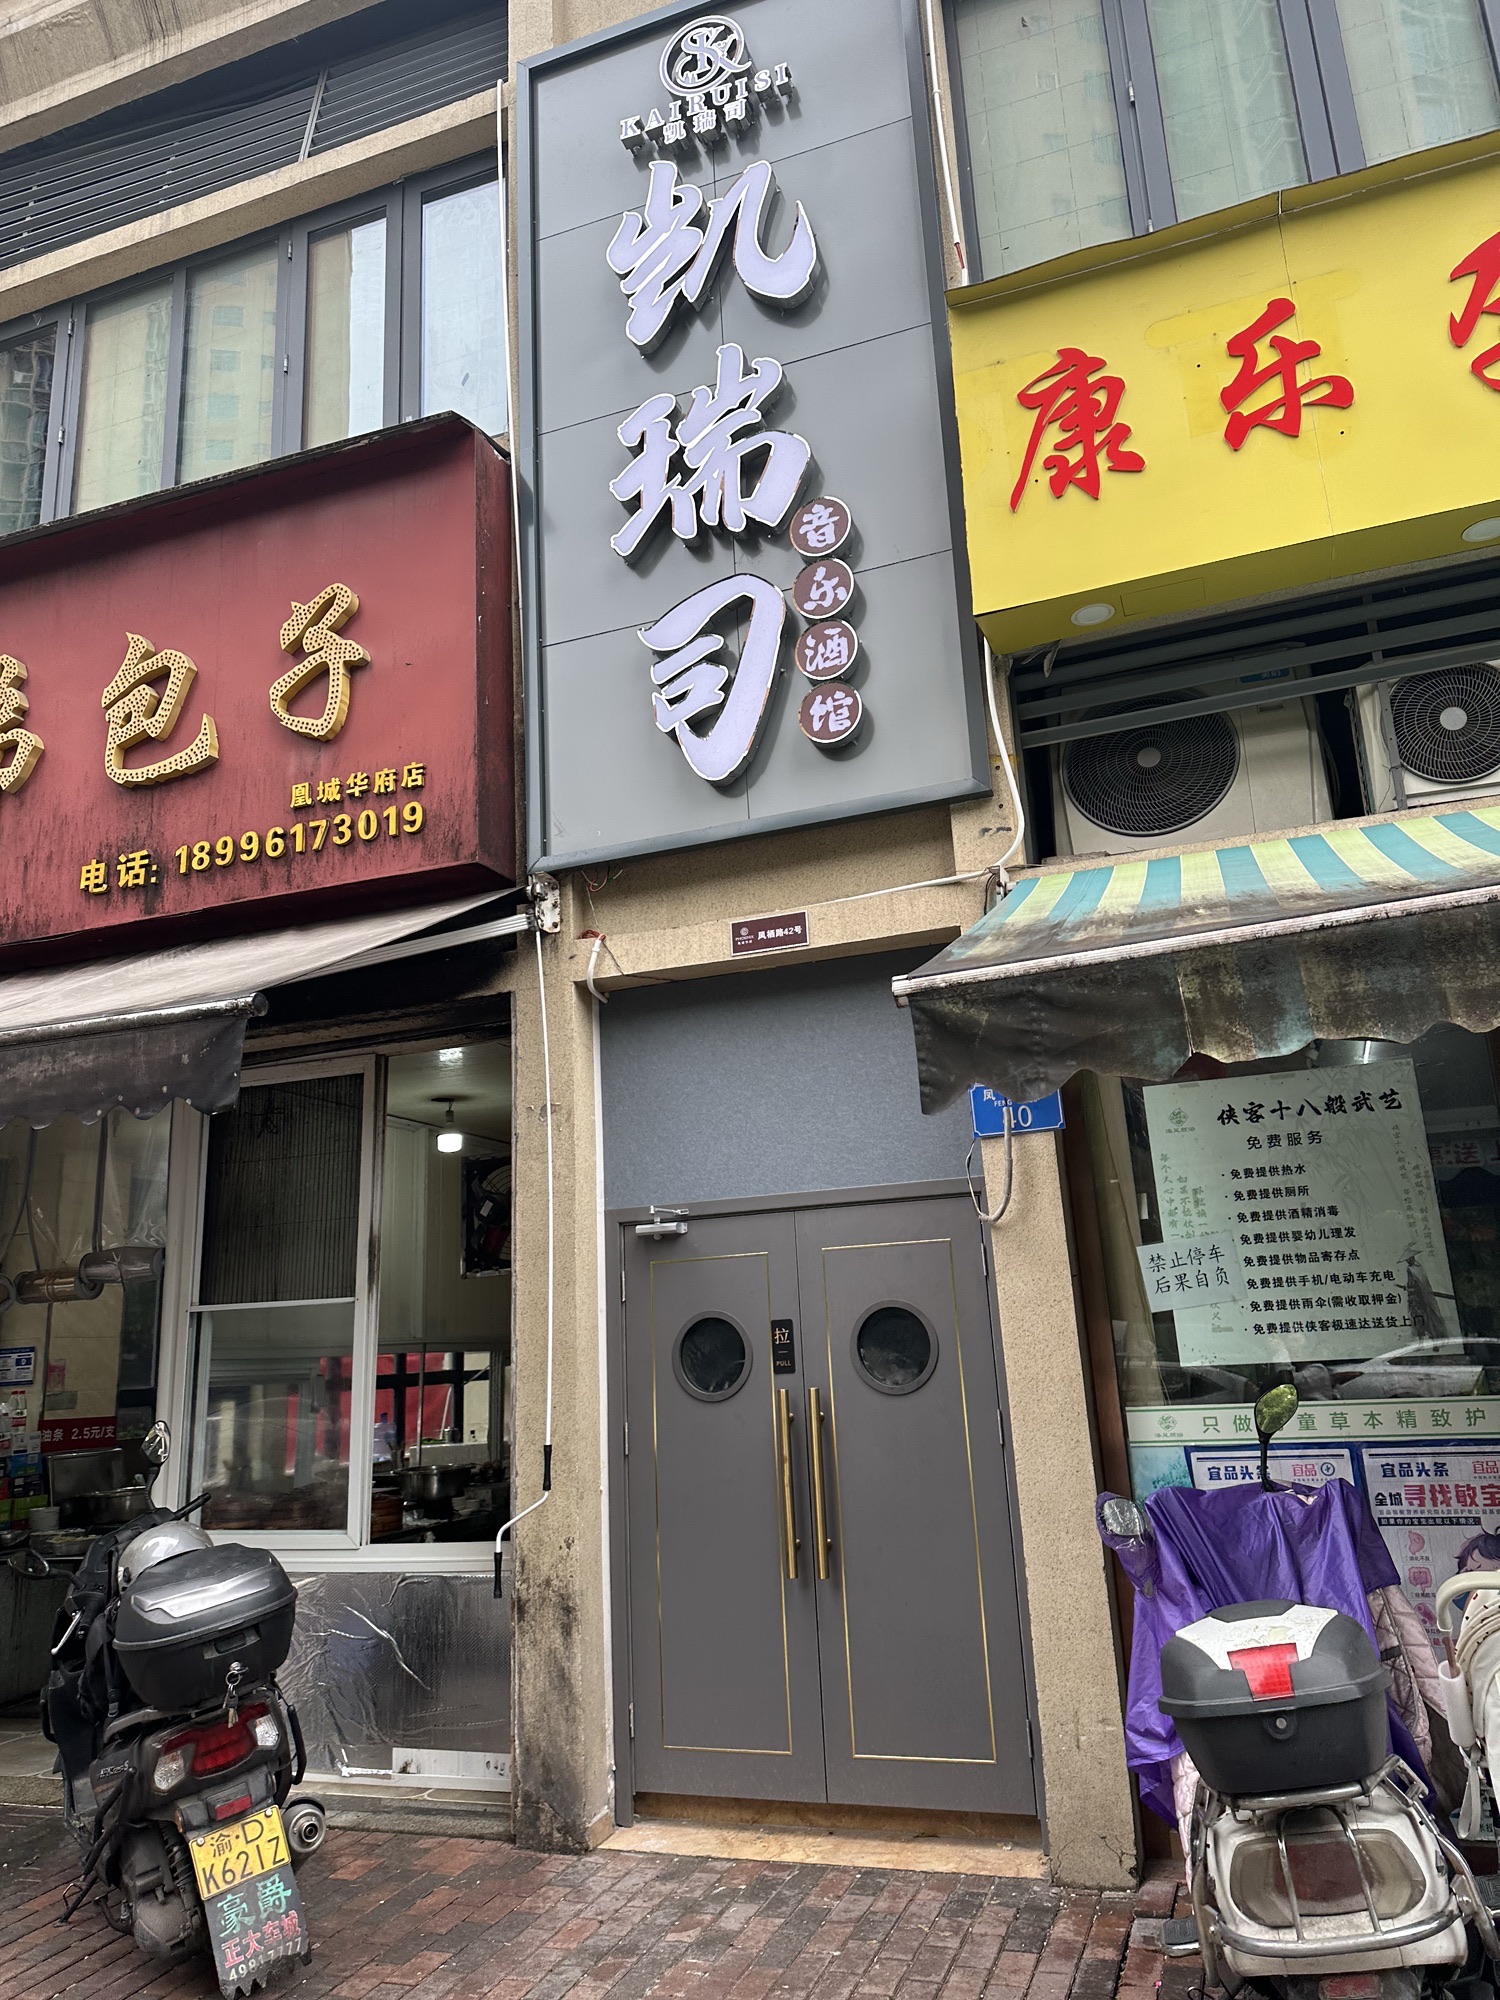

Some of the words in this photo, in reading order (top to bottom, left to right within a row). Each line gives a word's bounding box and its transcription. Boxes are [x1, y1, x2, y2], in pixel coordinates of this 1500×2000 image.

[620, 62, 788, 139] KAIRUISI
[663, 99, 747, 144] 凯瑞司
[606, 160, 817, 781] 凯瑞司
[799, 503, 854, 733] 音乐酒馆
[290, 762, 425, 808] 凰城华府店
[175, 800, 424, 875] 18996173019
[1217, 1088, 1402, 1126] 侠客十八般武艺
[1247, 1130, 1323, 1150] 免费服务
[1230, 1163, 1306, 1180] 免费提供热水
[1233, 1185, 1309, 1202] 免费提供厕所
[1237, 1205, 1339, 1223] 免费提供酒精消毒
[1240, 1226, 1356, 1246] 免费提供婴幼儿理发
[1148, 1244, 1225, 1273] 禁止停车
[1243, 1249, 1360, 1267] 免费提供物品寄存点
[1155, 1266, 1229, 1294] 后果自负
[1246, 1270, 1396, 1290] 免费提供手机/电动车充电
[1250, 1292, 1402, 1312] 免费提供雨伞(需收取押金)
[1253, 1315, 1426, 1335] 免费提供侠客极速达送货上门
[774, 1327, 790, 1344] 拉
[1202, 1407, 1486, 1434] 只做童草本精致护
[41, 1428, 64, 1442] 油条
[71, 1425, 115, 1440] 2.5元/支
[1292, 1464, 1317, 1477] 宜品
[1381, 1462, 1449, 1478] 宜品头条
[216, 1872, 292, 1938] 豪爵
[221, 1909, 301, 1969] 正大车城
